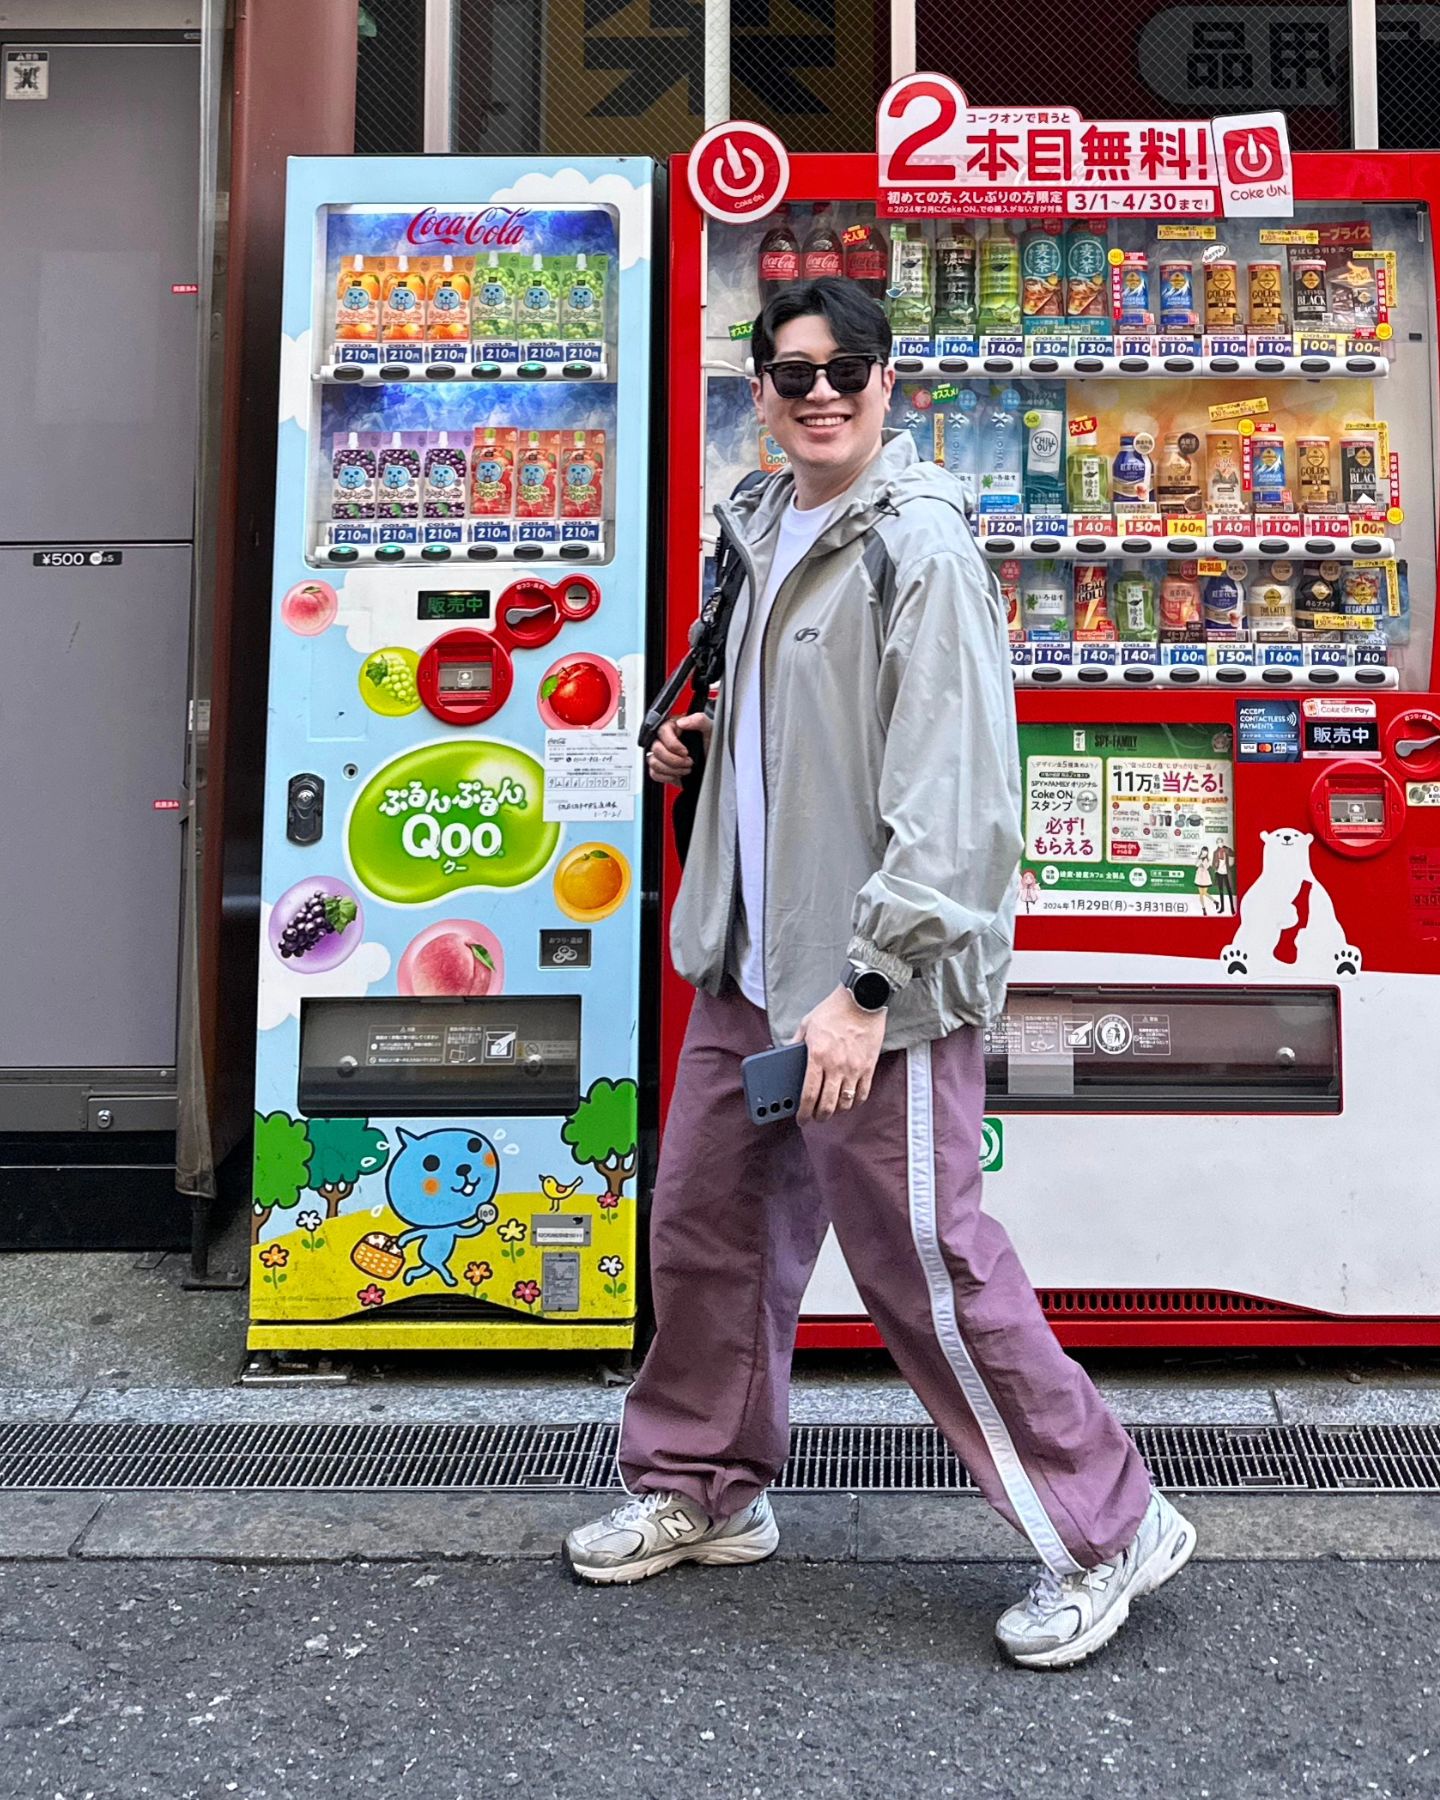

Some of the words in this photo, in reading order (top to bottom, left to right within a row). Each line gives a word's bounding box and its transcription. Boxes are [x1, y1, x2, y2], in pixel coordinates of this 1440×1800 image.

[966, 112, 1071, 124] コークオンで買うと
[887, 191, 1063, 204] 初めての方、久しぶりの方限定
[1230, 189, 1264, 201] Coke
[407, 207, 533, 245] Coca-Cola
[842, 228, 867, 243] 大人気
[1035, 243, 1051, 273] 麦茶
[1079, 243, 1096, 273] 麦茶
[1297, 296, 1326, 306] BLACK
[901, 343, 930, 353] 160円
[944, 343, 973, 353] 160円
[990, 343, 1022, 354] 140円
[1035, 343, 1067, 354] 130円
[1080, 343, 1112, 354] 130円
[1161, 343, 1194, 353] 110円
[1213, 343, 1246, 353] 110円
[1258, 342, 1292, 353] 110円
[1302, 340, 1336, 351] 100円
[1347, 341, 1380, 352] 100円
[345, 350, 375, 360] 210円
[389, 350, 419, 360] 210円
[434, 350, 464, 359] 210円
[485, 349, 516, 359] 210円
[530, 348, 560, 359] 210円
[569, 348, 599, 359] 210円
[1070, 420, 1095, 433] 大人気
[1034, 435, 1056, 446] CHILL
[765, 455, 787, 464] Qoo
[990, 521, 1022, 532] 120円
[1035, 521, 1065, 532] 210円
[1076, 522, 1112, 532] 140円
[1126, 522, 1161, 532] 150円
[1173, 522, 1202, 532] 160円
[1214, 522, 1250, 532] 140円
[1264, 522, 1299, 533] 110円
[1313, 522, 1348, 533] 110円
[1354, 523, 1385, 534] 100円
[337, 529, 368, 540] 210円
[382, 529, 413, 541] 210円
[428, 528, 458, 540] 210円
[477, 528, 507, 538] 210円
[522, 528, 552, 538] 210円
[565, 527, 595, 538] 210円
[42, 553, 84, 565] ¥500
[1078, 580, 1103, 592] REAL
[1078, 590, 1105, 602] GOLD
[427, 597, 483, 613] 販売中
[1037, 650, 1070, 661] 110円
[1083, 651, 1114, 661] 140円
[1124, 650, 1156, 661] 140円
[1174, 651, 1204, 661] 160円
[1218, 651, 1253, 662] 150円
[1268, 651, 1299, 662] 160円
[1313, 651, 1346, 662] 140円
[1356, 652, 1386, 662] 140円
[1239, 708, 1265, 716] ACCEPT
[1354, 707, 1369, 715] Pay
[1239, 715, 1286, 723] CONTACTLESS
[1313, 726, 1369, 744] 販売中
[379, 779, 524, 817] ぷるんぷるん
[1031, 790, 1055, 799] Coke
[1056, 790, 1073, 799] ON
[1031, 800, 1073, 811] スタンプ
[1045, 816, 1085, 836] 必ず!
[402, 813, 503, 860] Qoo
[1034, 836, 1094, 856] もらえる
[444, 861, 467, 874] クー
